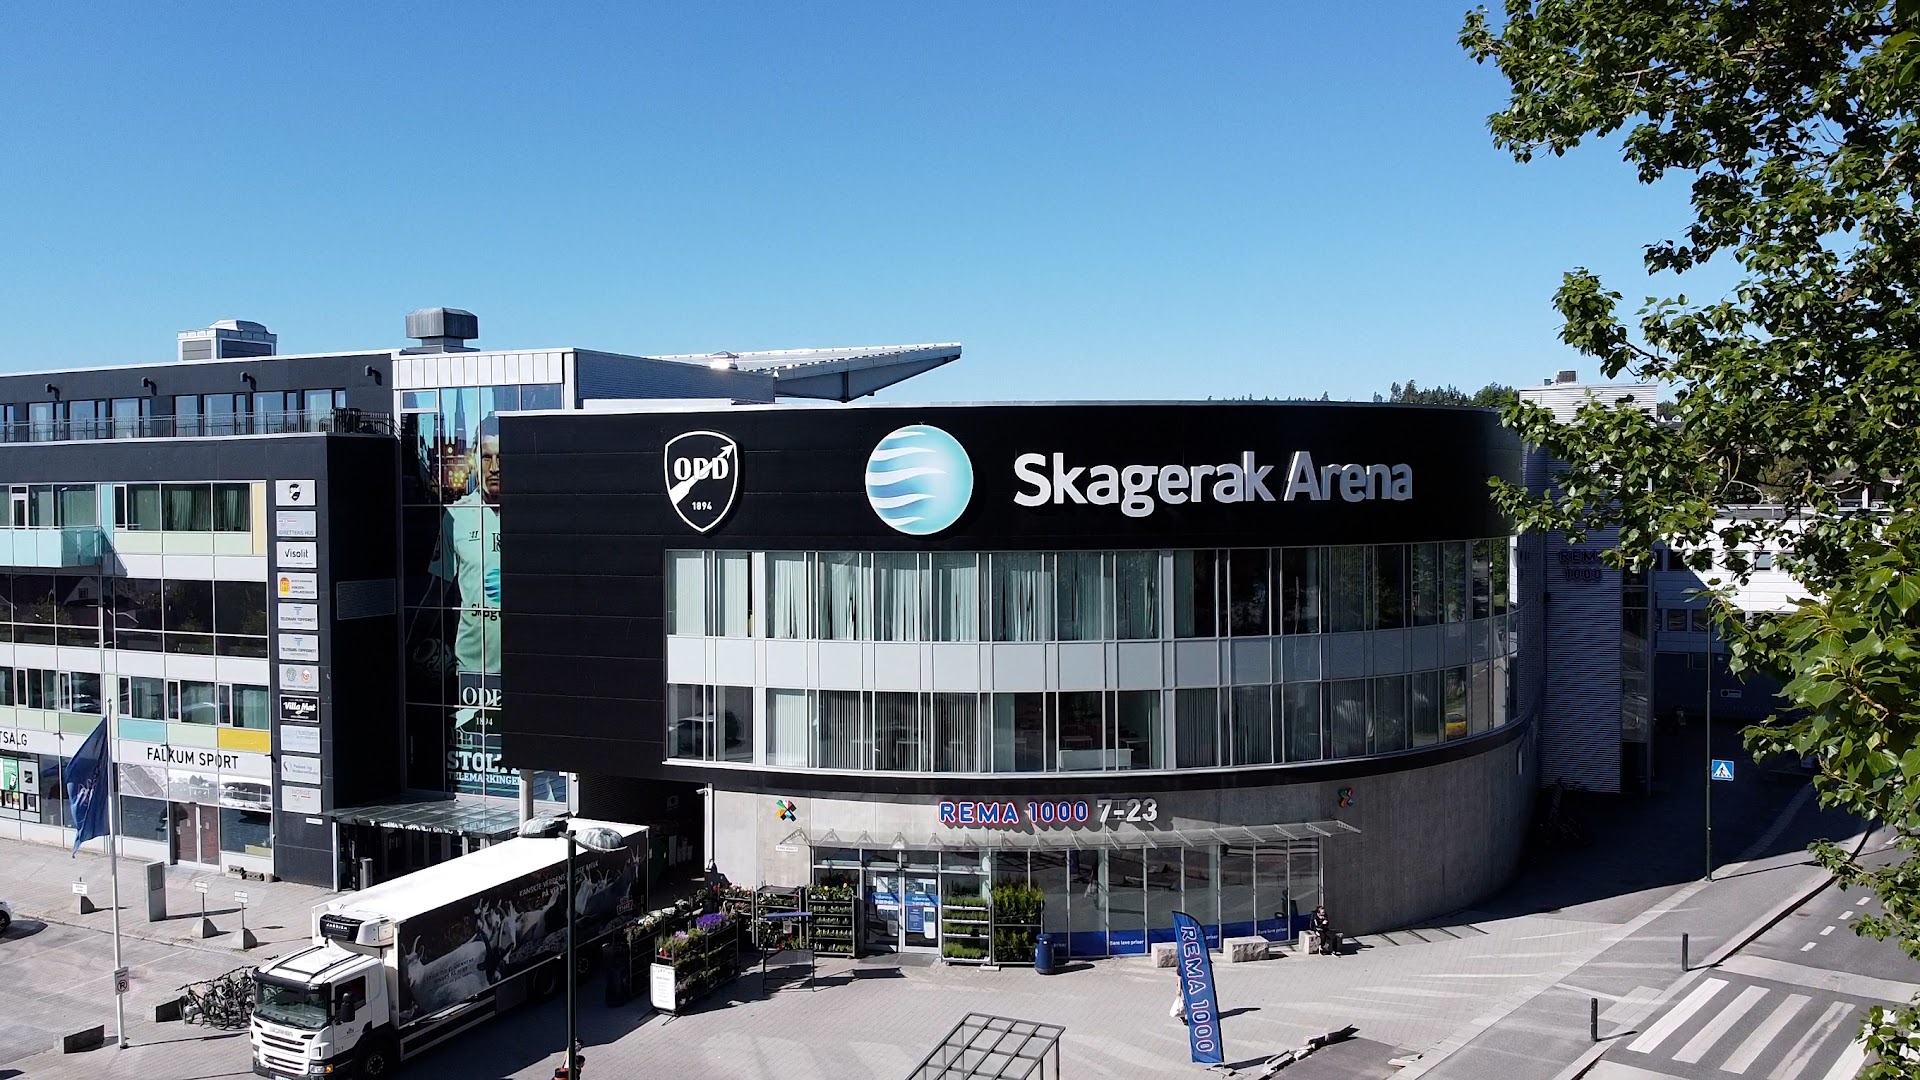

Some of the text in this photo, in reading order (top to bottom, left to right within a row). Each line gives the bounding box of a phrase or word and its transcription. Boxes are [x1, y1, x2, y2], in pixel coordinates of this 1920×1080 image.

[673, 457, 729, 481] ODD
[1014, 450, 1413, 518] Skagerak Arena
[691, 501, 713, 511] 1894
[284, 548, 309, 559] Visolit
[1558, 549, 1604, 563] REM
[1564, 567, 1603, 581] 1000
[283, 701, 317, 715] Villa Mat
[0, 730, 28, 746] SALG
[147, 746, 239, 769] FALKUM SPORT
[447, 770, 522, 786] TELEMARKINGE
[939, 798, 1159, 824] REMA 1000 7-23
[1181, 926, 1215, 1053] REMA 1000
